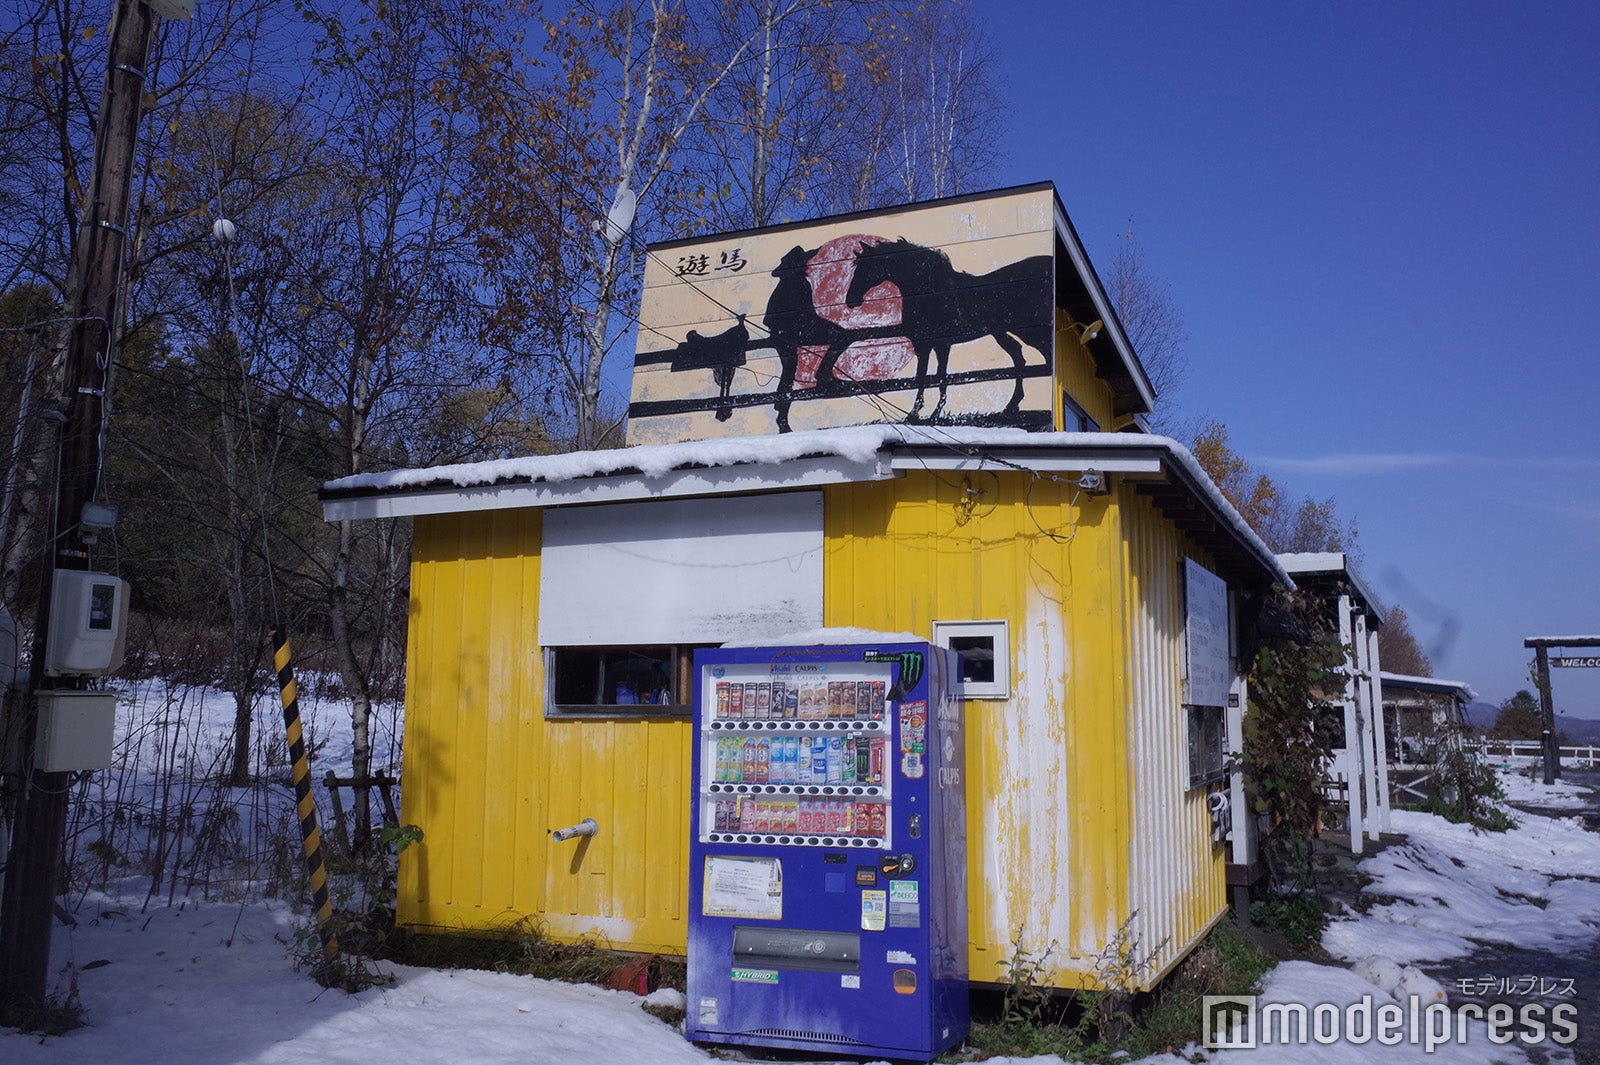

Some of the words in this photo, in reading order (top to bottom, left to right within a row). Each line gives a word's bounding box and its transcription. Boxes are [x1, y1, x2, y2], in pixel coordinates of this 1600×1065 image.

[675, 248, 748, 277] 遊馬
[794, 665, 818, 673] CALPIS
[938, 767, 960, 789] CALPIS
